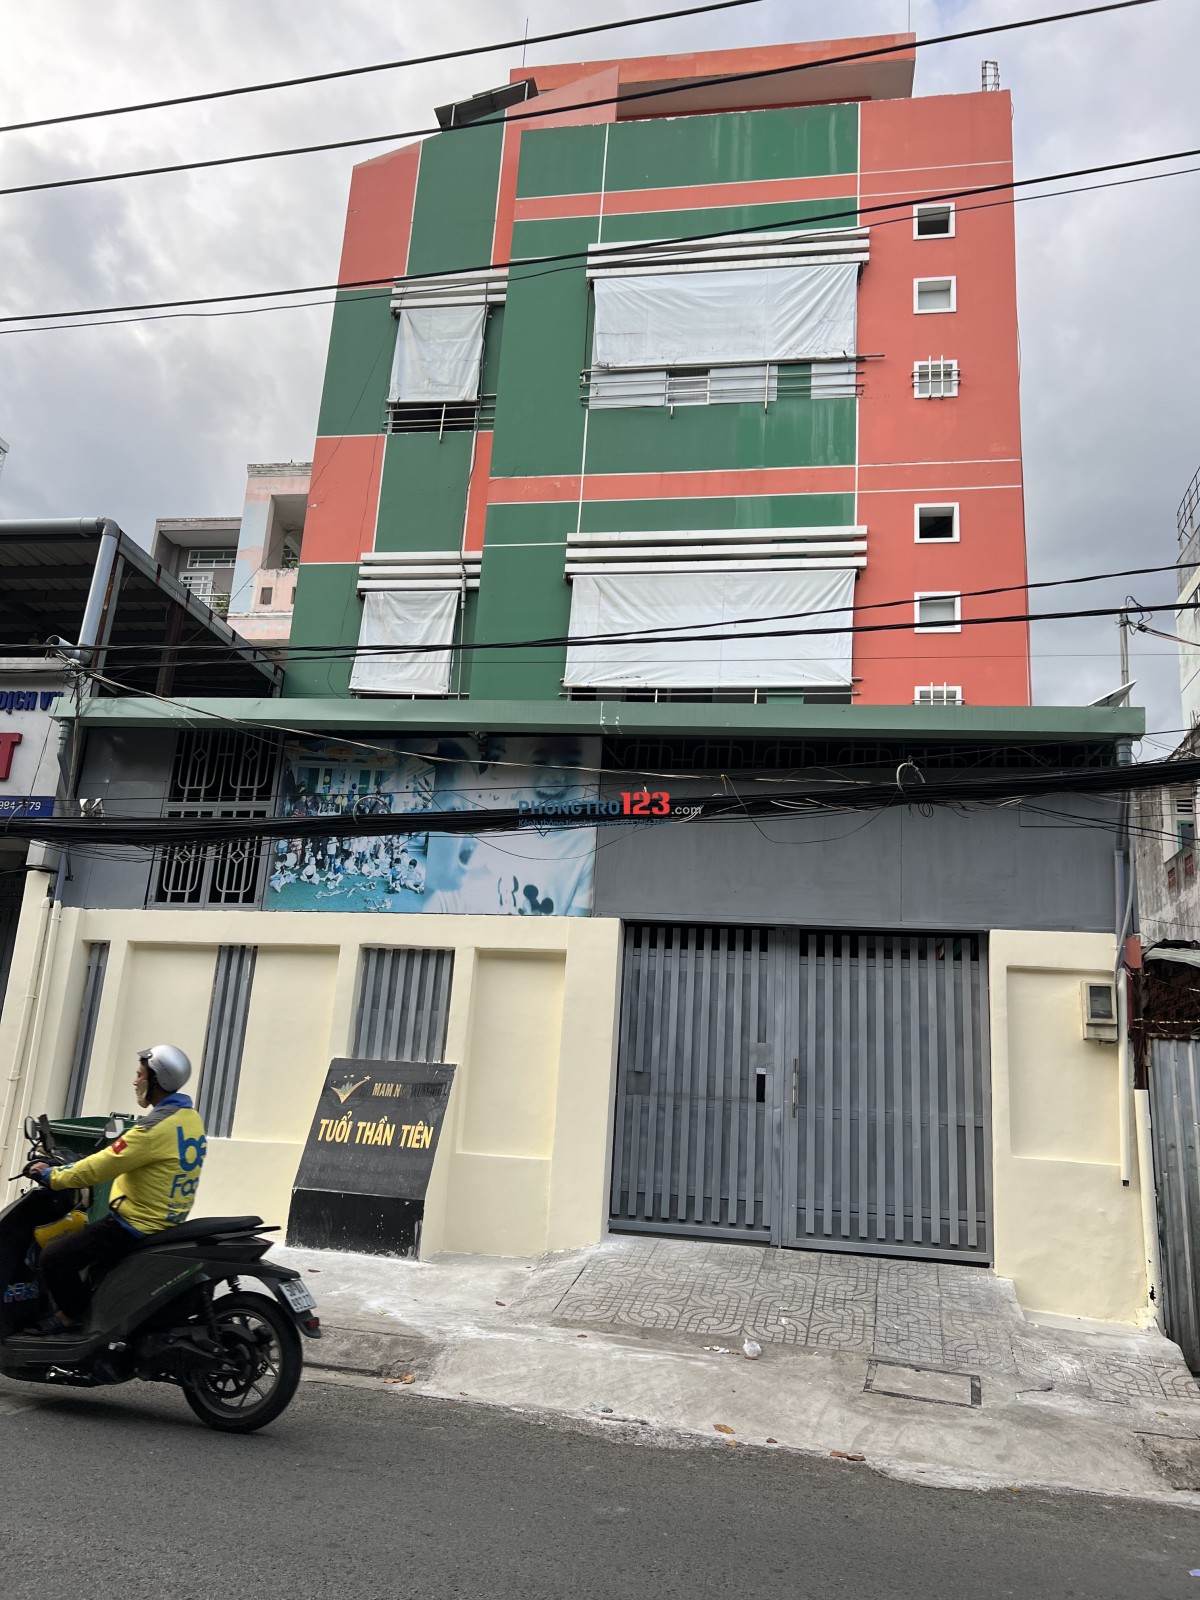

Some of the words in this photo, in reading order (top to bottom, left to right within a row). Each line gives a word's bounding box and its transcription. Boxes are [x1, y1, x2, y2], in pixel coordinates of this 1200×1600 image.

[318, 1111, 353, 1143] TUỔI
[355, 1116, 396, 1146] THẦN
[399, 1120, 434, 1149] TIÊN
